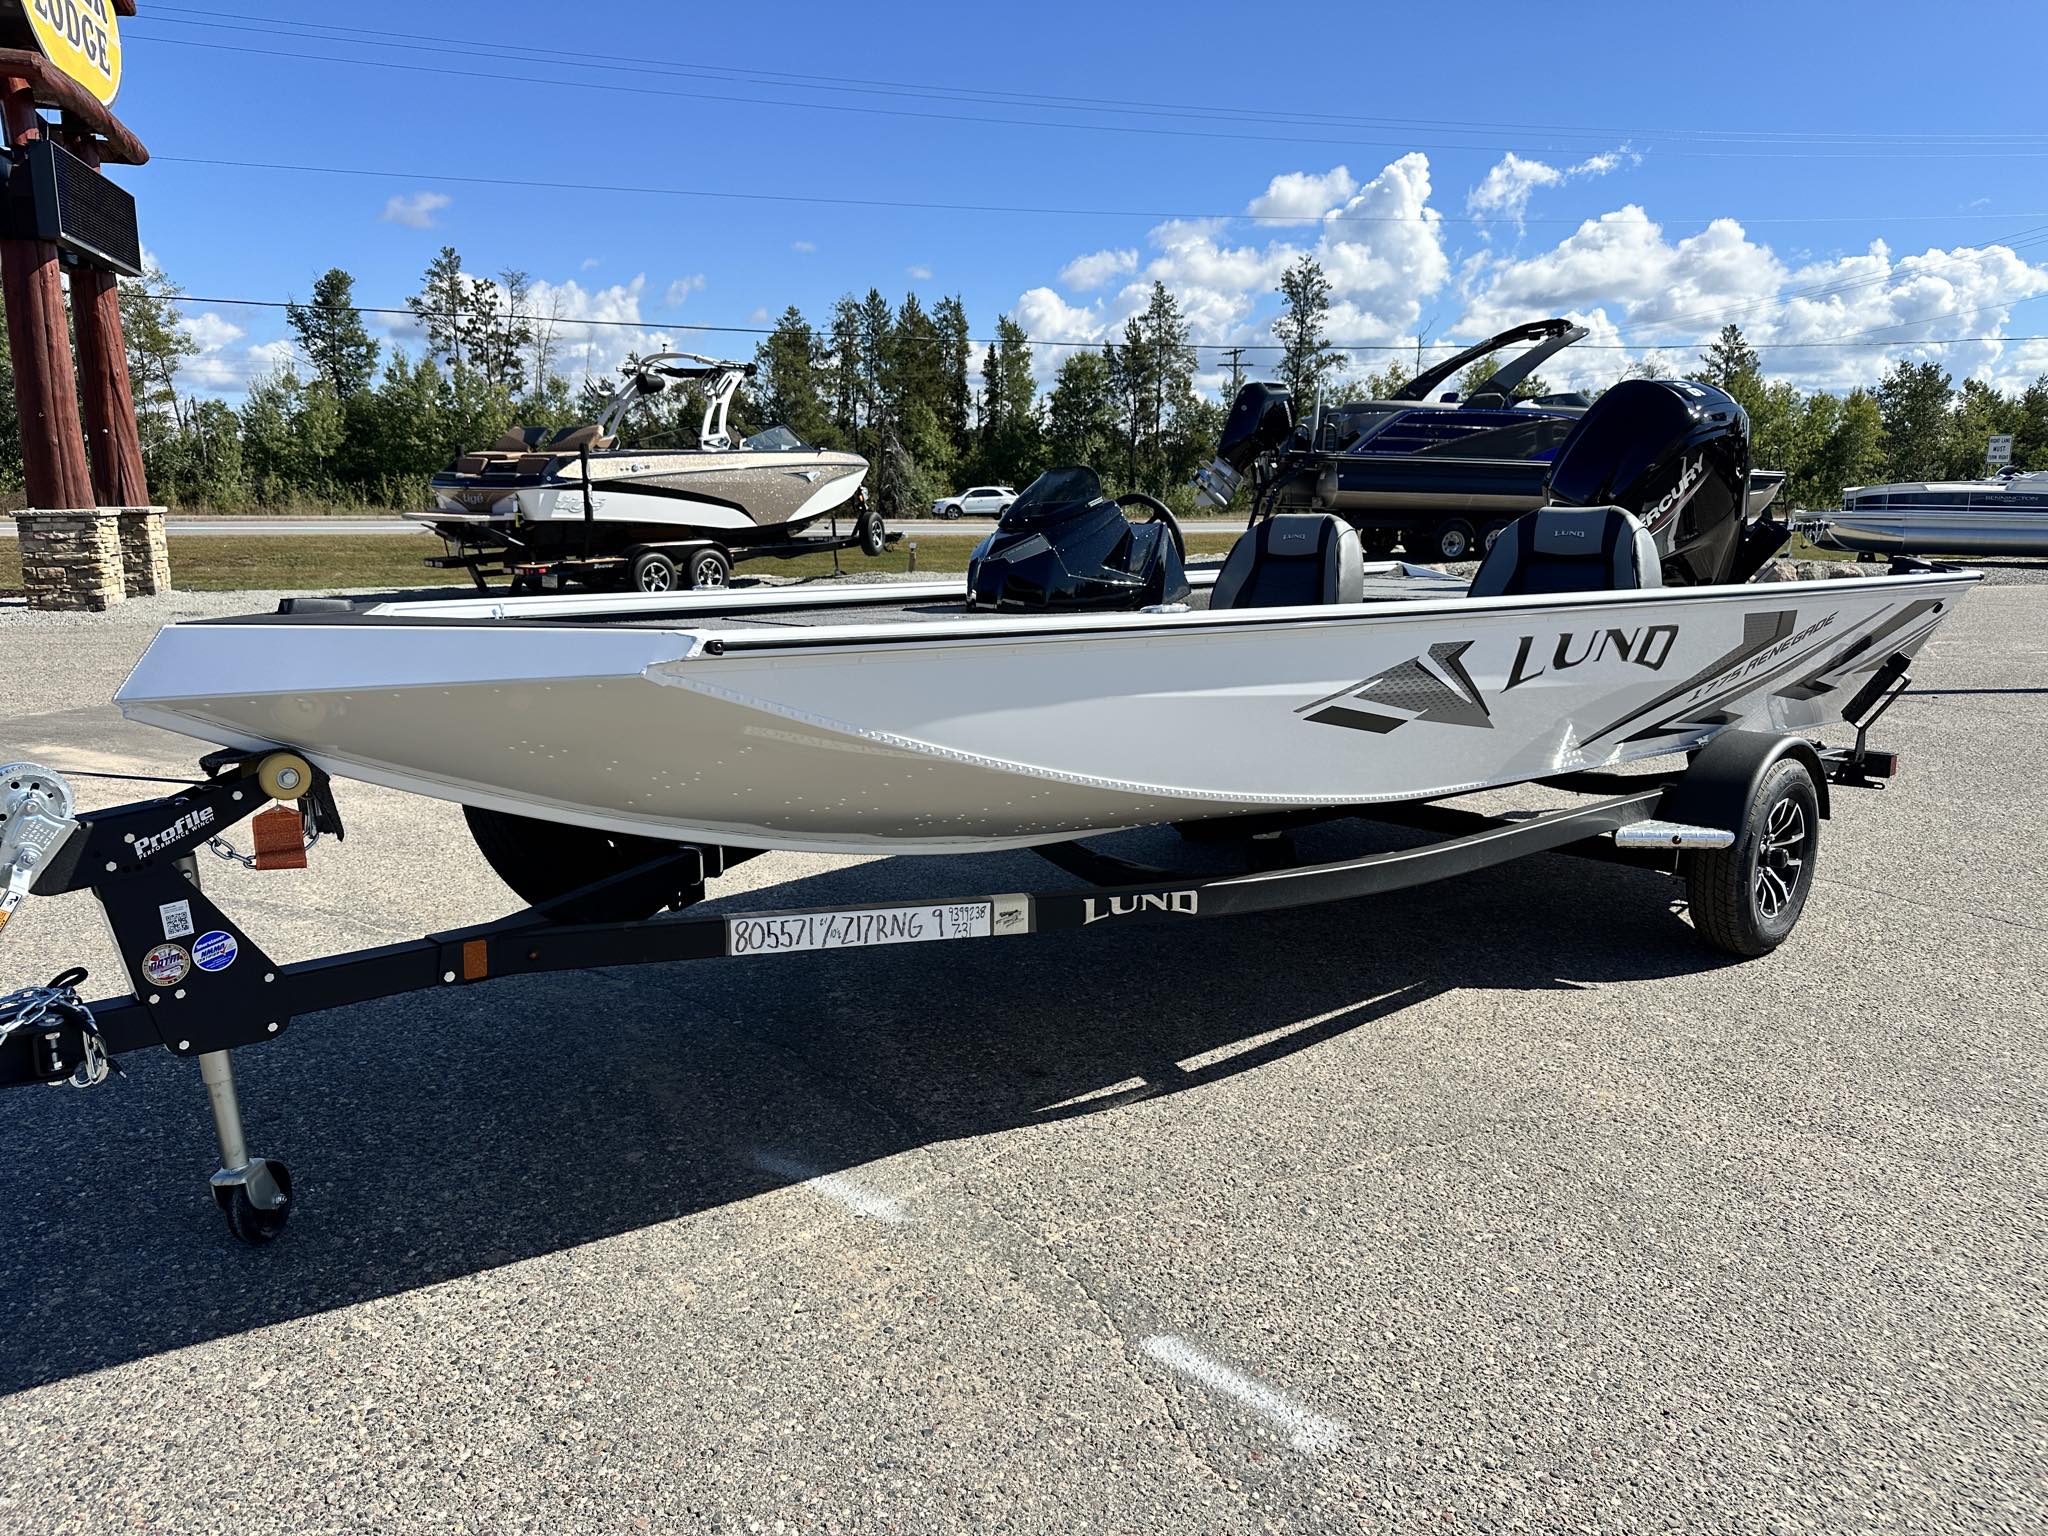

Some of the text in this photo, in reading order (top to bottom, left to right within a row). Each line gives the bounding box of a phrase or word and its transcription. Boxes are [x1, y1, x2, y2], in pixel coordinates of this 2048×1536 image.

[1640, 452, 1704, 529] ERCURY
[1553, 530, 1585, 538] LUND
[1500, 624, 1680, 694] LUND
[1687, 609, 1841, 703] 1775 RENEGADE
[133, 806, 214, 856] Profile
[138, 816, 215, 861] PERFORMANCE WINCH
[948, 905, 987, 923] 9399238
[1082, 889, 1199, 925] LUND
[734, 917, 814, 953] 805571
[931, 908, 944, 937] 9
[951, 922, 972, 939] 7-31
